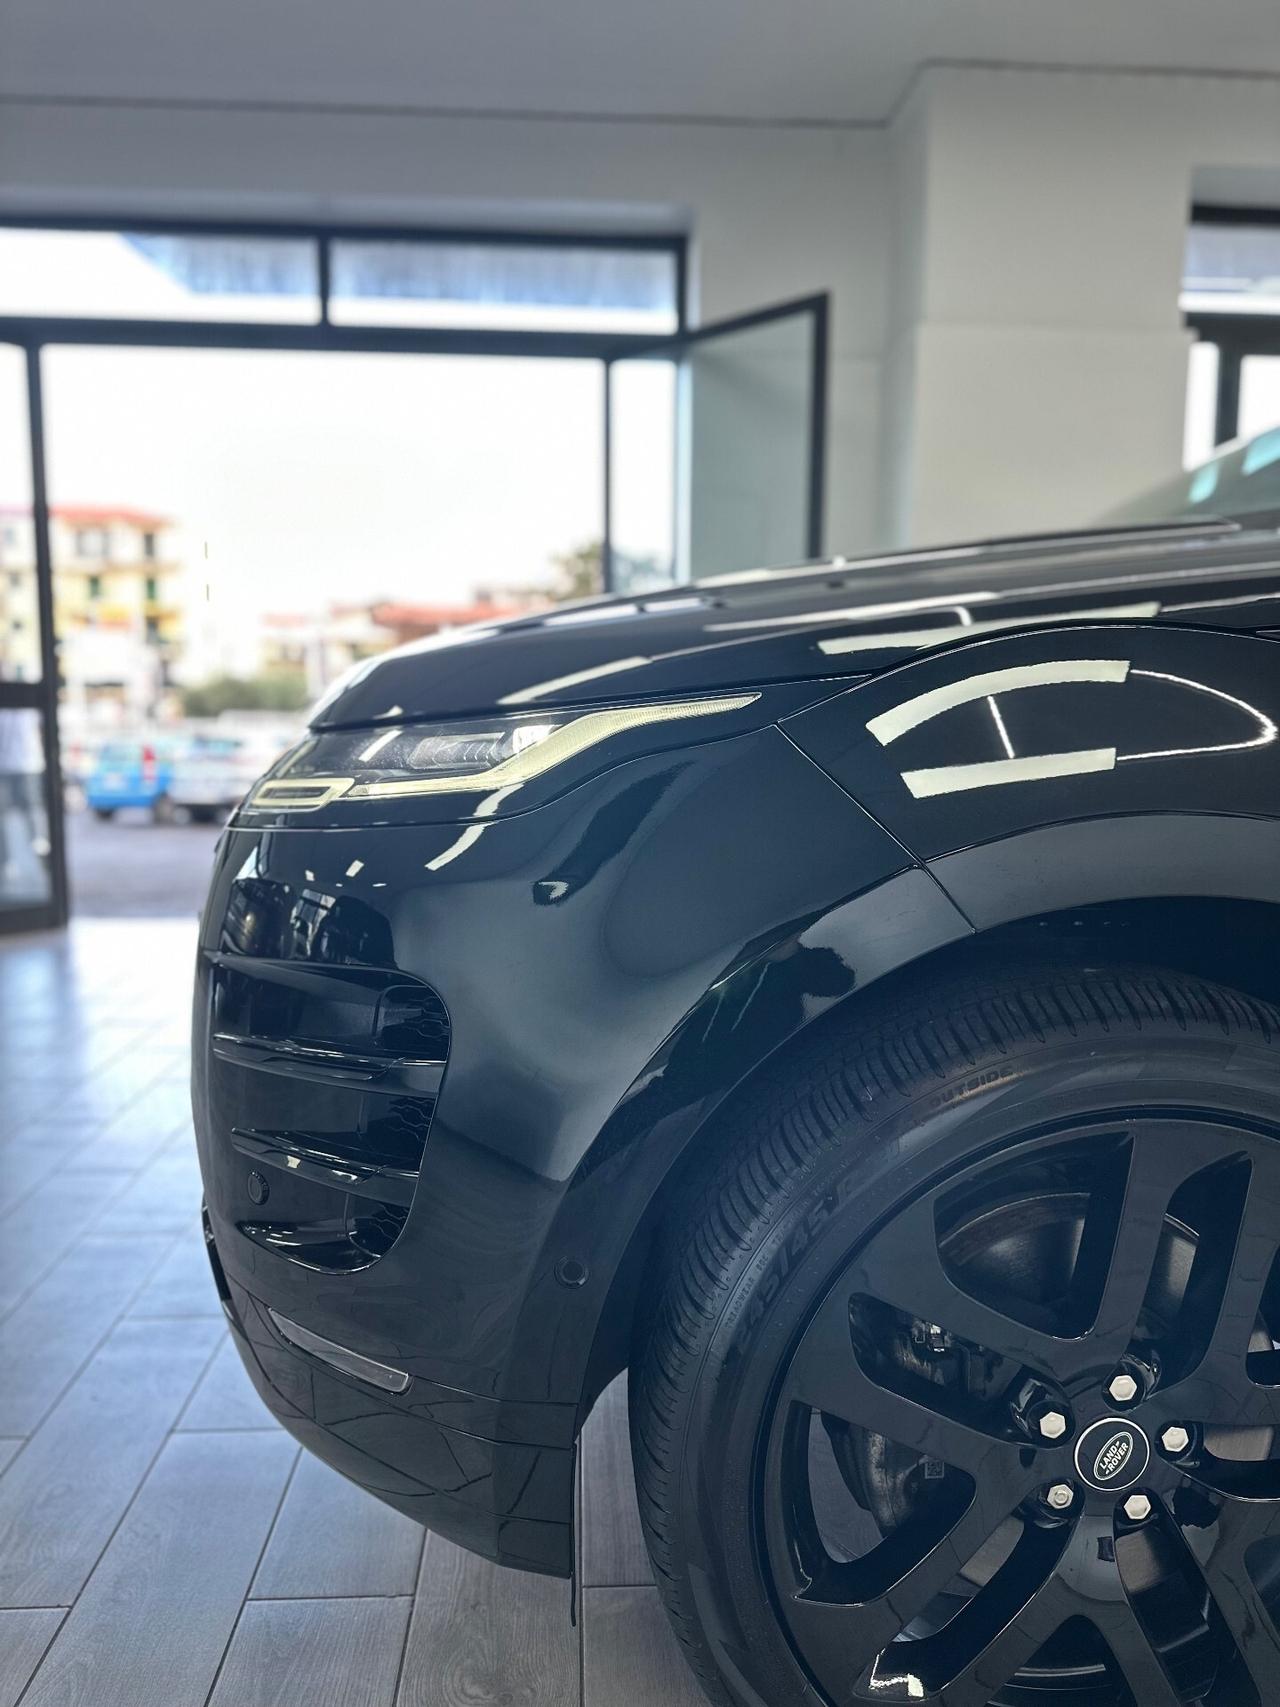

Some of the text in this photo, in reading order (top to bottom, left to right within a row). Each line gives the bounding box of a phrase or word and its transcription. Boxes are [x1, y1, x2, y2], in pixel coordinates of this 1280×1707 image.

[928, 1065, 1014, 1109] OUTSIDE
[1099, 1445, 1118, 1470] LAND
[1107, 1442, 1129, 1472] ROVER
